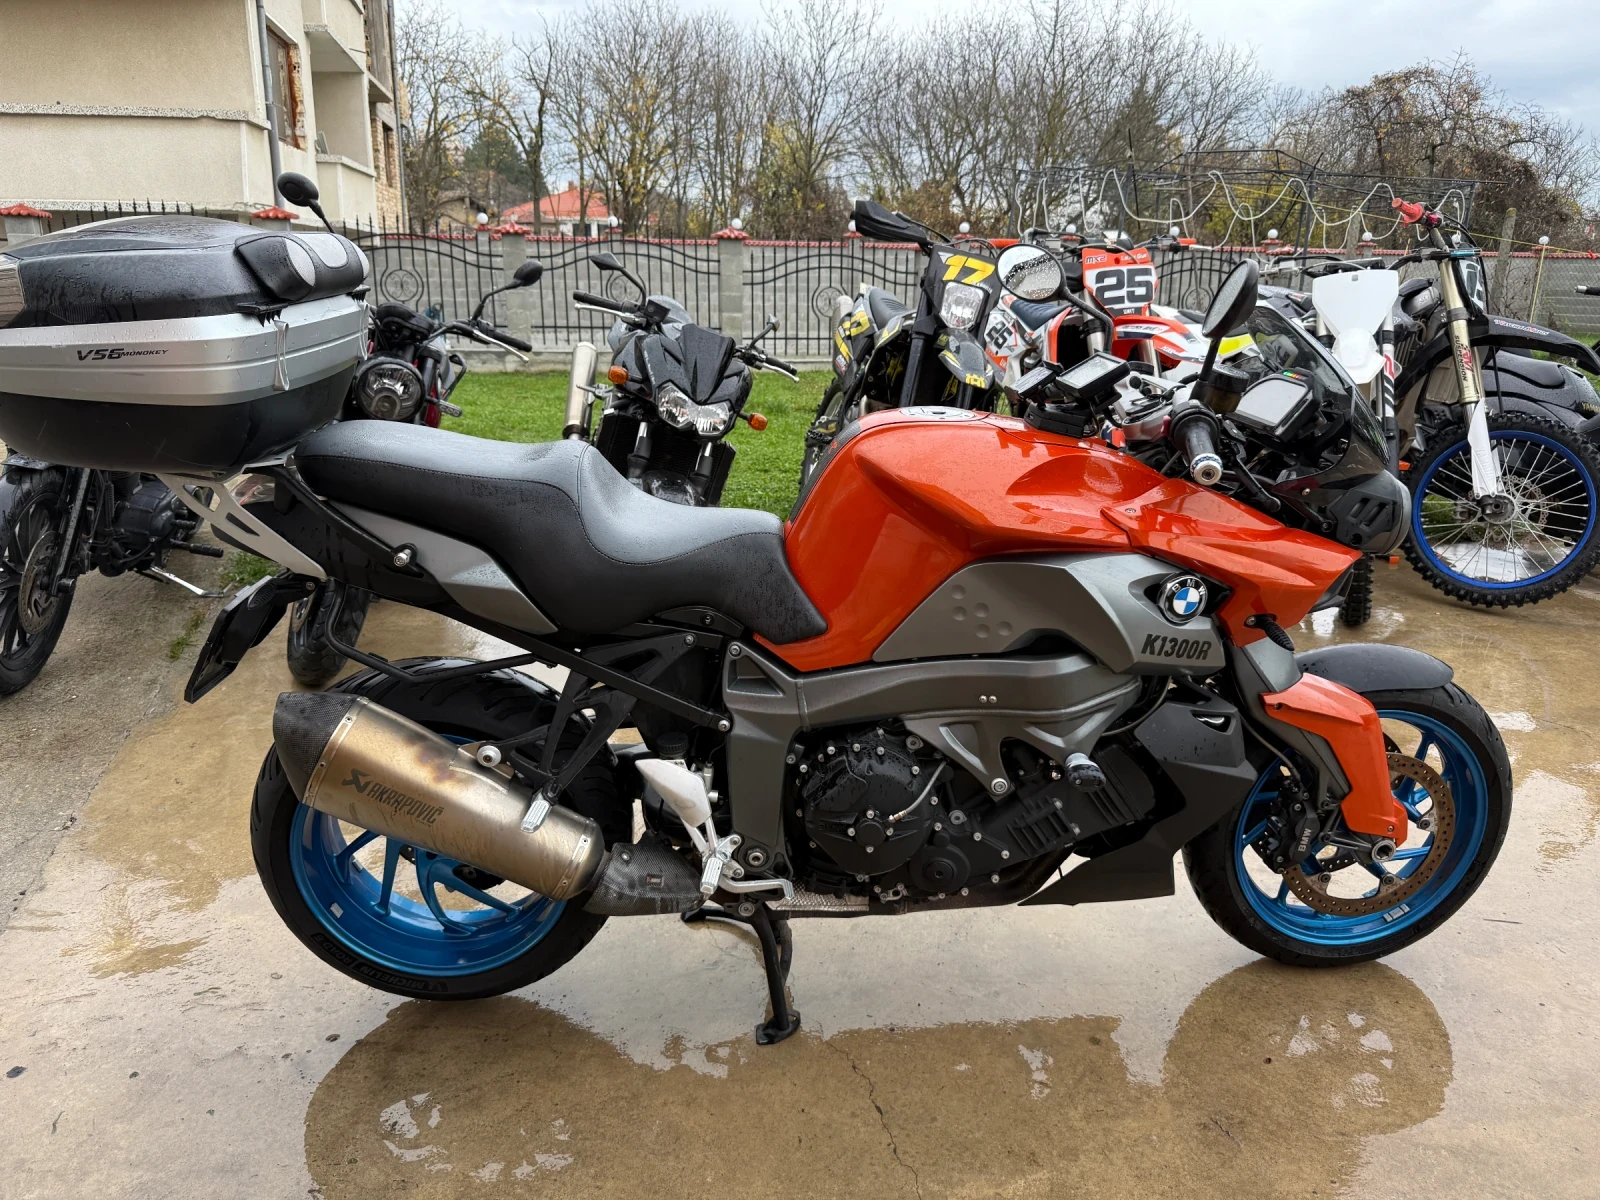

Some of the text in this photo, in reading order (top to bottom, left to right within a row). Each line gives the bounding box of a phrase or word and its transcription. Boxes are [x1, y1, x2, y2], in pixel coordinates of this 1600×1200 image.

[942, 254, 996, 285] 17
[1095, 268, 1154, 306] 25
[77, 348, 169, 361] V56 MONOKEY
[1454, 335, 1468, 382] SUSPENSION
[1172, 578, 1207, 596] BMW
[1141, 633, 1212, 660] K1300R
[1298, 828, 1312, 852] BMW
[323, 942, 353, 965] ROAD
[360, 964, 425, 990] MICHELIN
